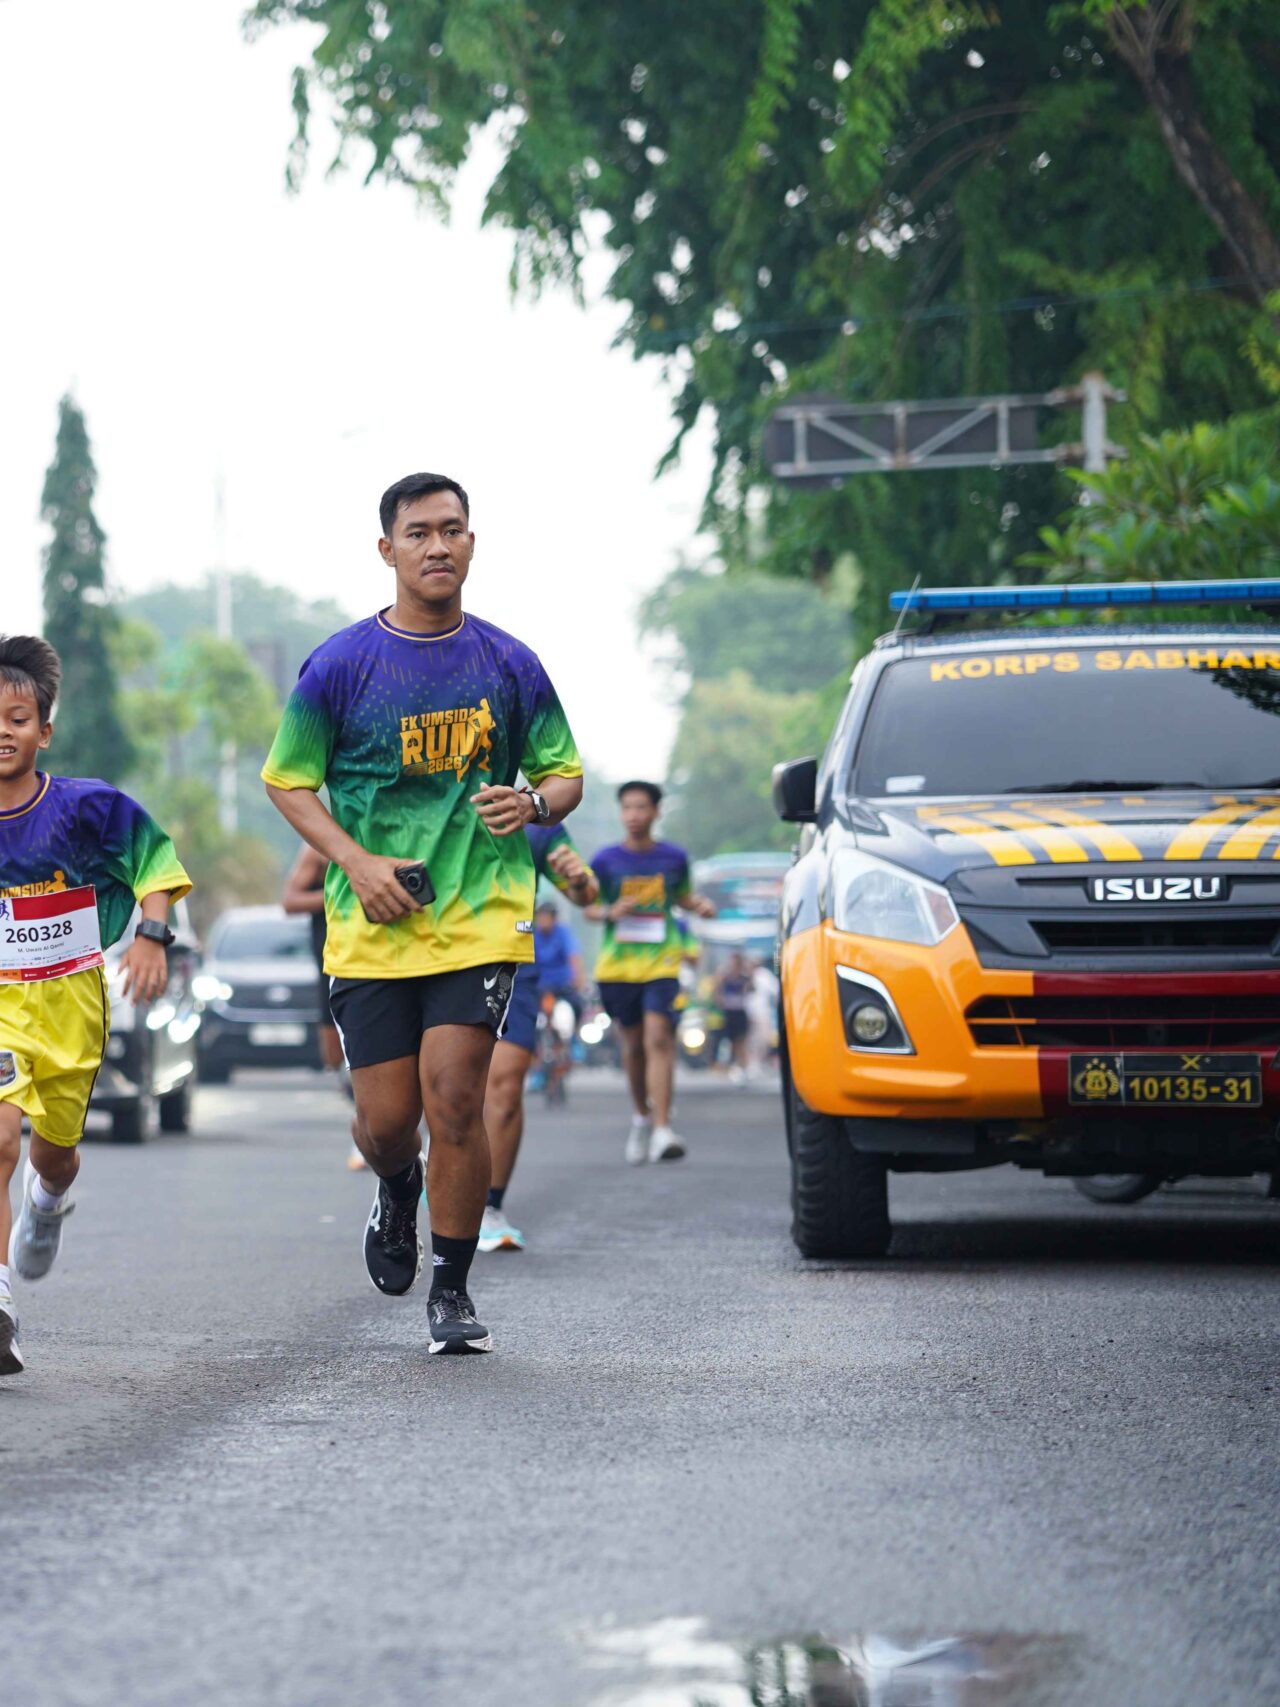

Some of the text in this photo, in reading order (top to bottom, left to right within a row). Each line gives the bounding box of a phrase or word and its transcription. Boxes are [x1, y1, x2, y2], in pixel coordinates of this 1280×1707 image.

[929, 651, 1080, 682] KORPS
[400, 715, 418, 732] FK
[400, 722, 475, 766] RUN
[428, 756, 463, 774] 2026
[1094, 877, 1220, 901] ISUZU
[4, 920, 73, 944] 260328
[1129, 1076, 1252, 1102] 10135-31
